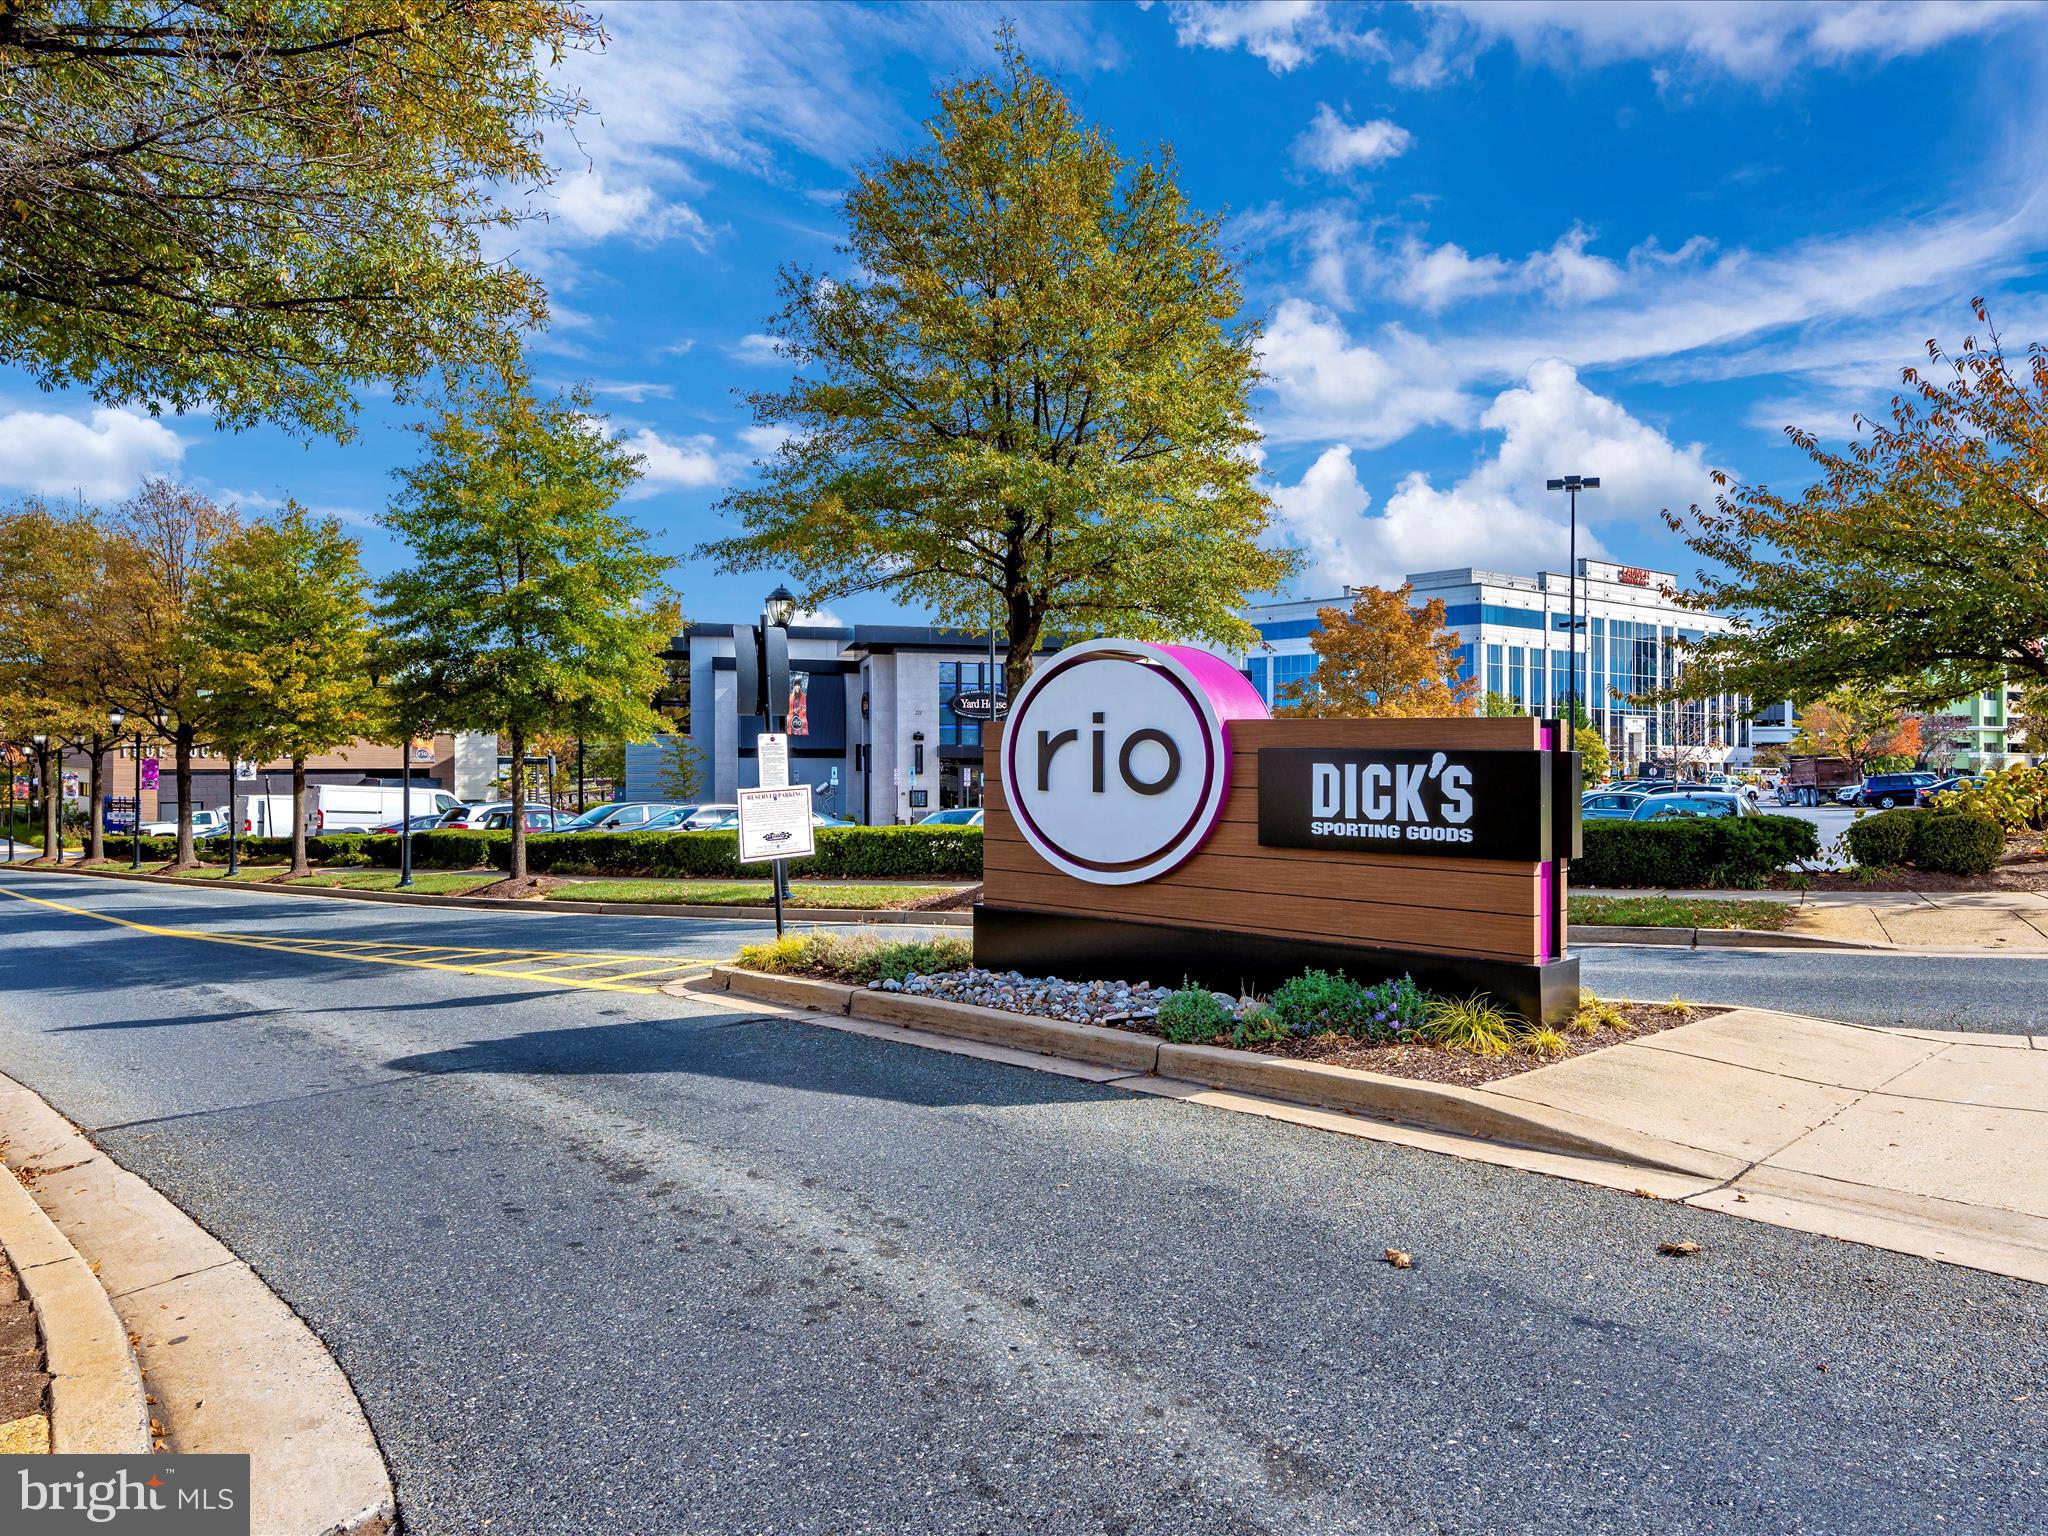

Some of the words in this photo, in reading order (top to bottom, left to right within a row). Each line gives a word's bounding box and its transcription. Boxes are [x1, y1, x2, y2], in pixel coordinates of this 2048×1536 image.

[960, 699, 980, 709] Yard
[981, 699, 1008, 709] Huse
[1036, 711, 1182, 796] rio
[1311, 751, 1474, 824] DICK'S
[1310, 821, 1401, 840] SPORTING
[1406, 826, 1474, 844] GOODS
